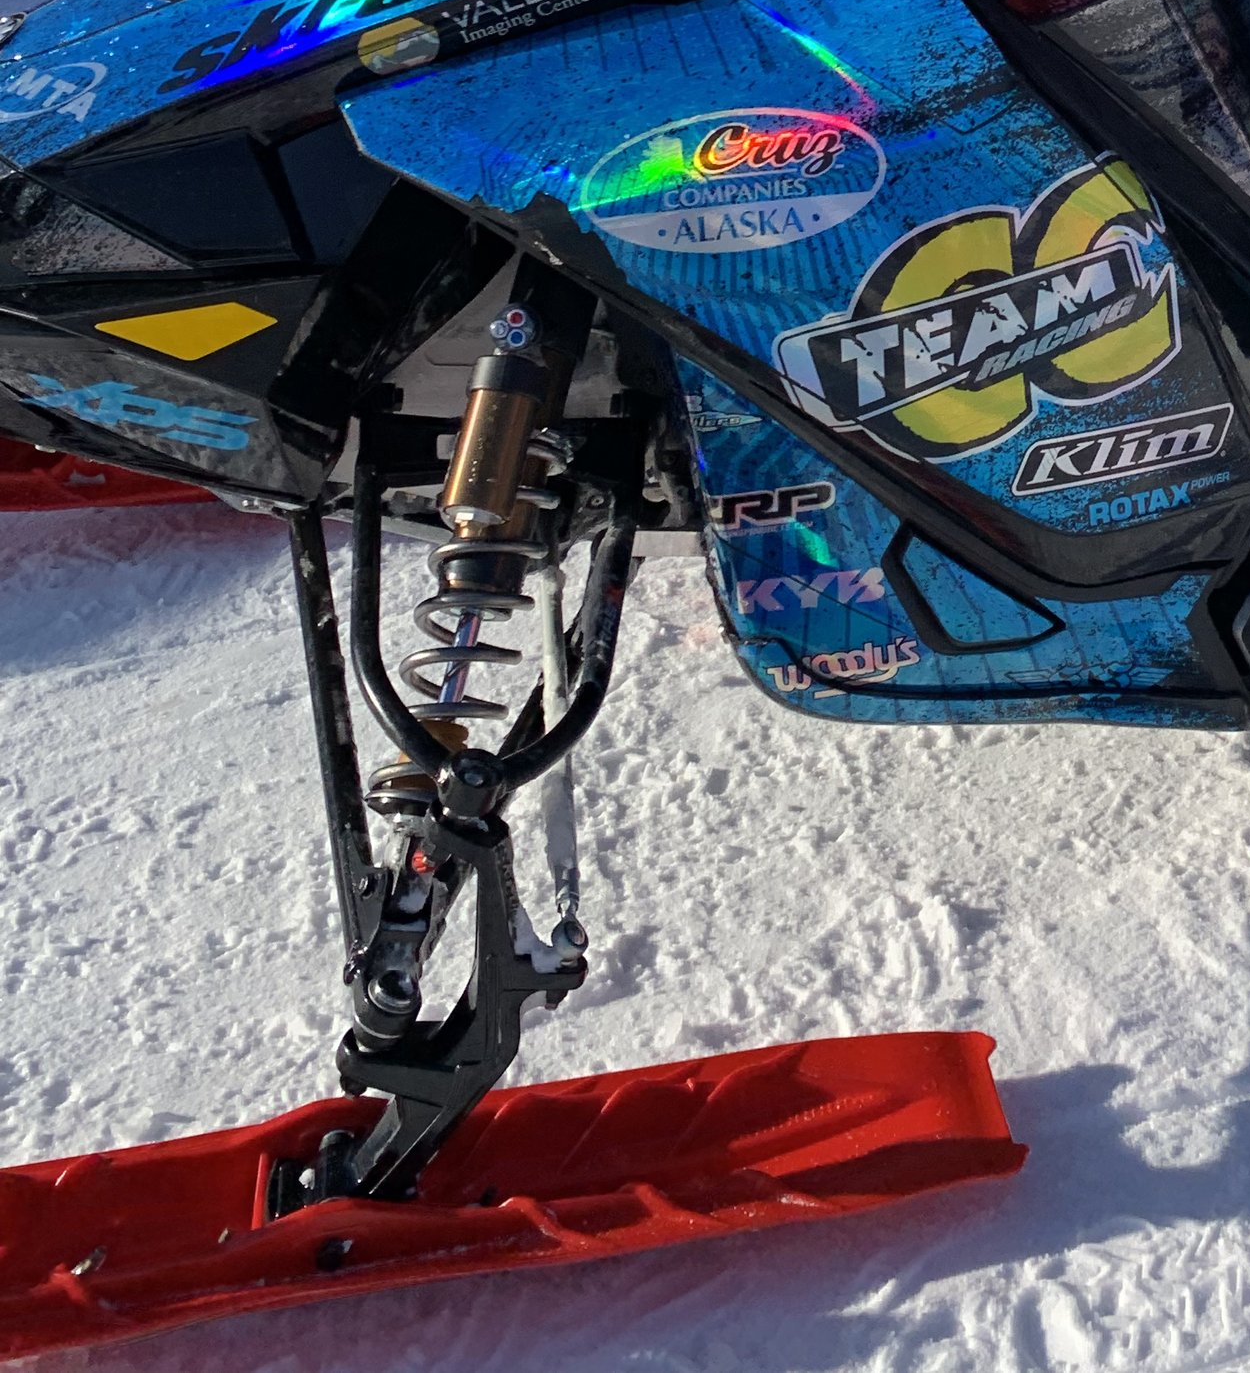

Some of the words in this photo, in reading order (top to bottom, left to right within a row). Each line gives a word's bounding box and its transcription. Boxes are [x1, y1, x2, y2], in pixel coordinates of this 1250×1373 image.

[459, 9, 536, 44] Imaging
[7, 67, 97, 122] MTA
[663, 179, 808, 209] COMPANIES
[672, 206, 804, 245] ALASKA
[840, 259, 1117, 408] TEAM
[973, 292, 1138, 385] RACING
[1088, 481, 1193, 527] ROTAX
[1192, 471, 1231, 491] POWER
[736, 567, 886, 615] KYB
